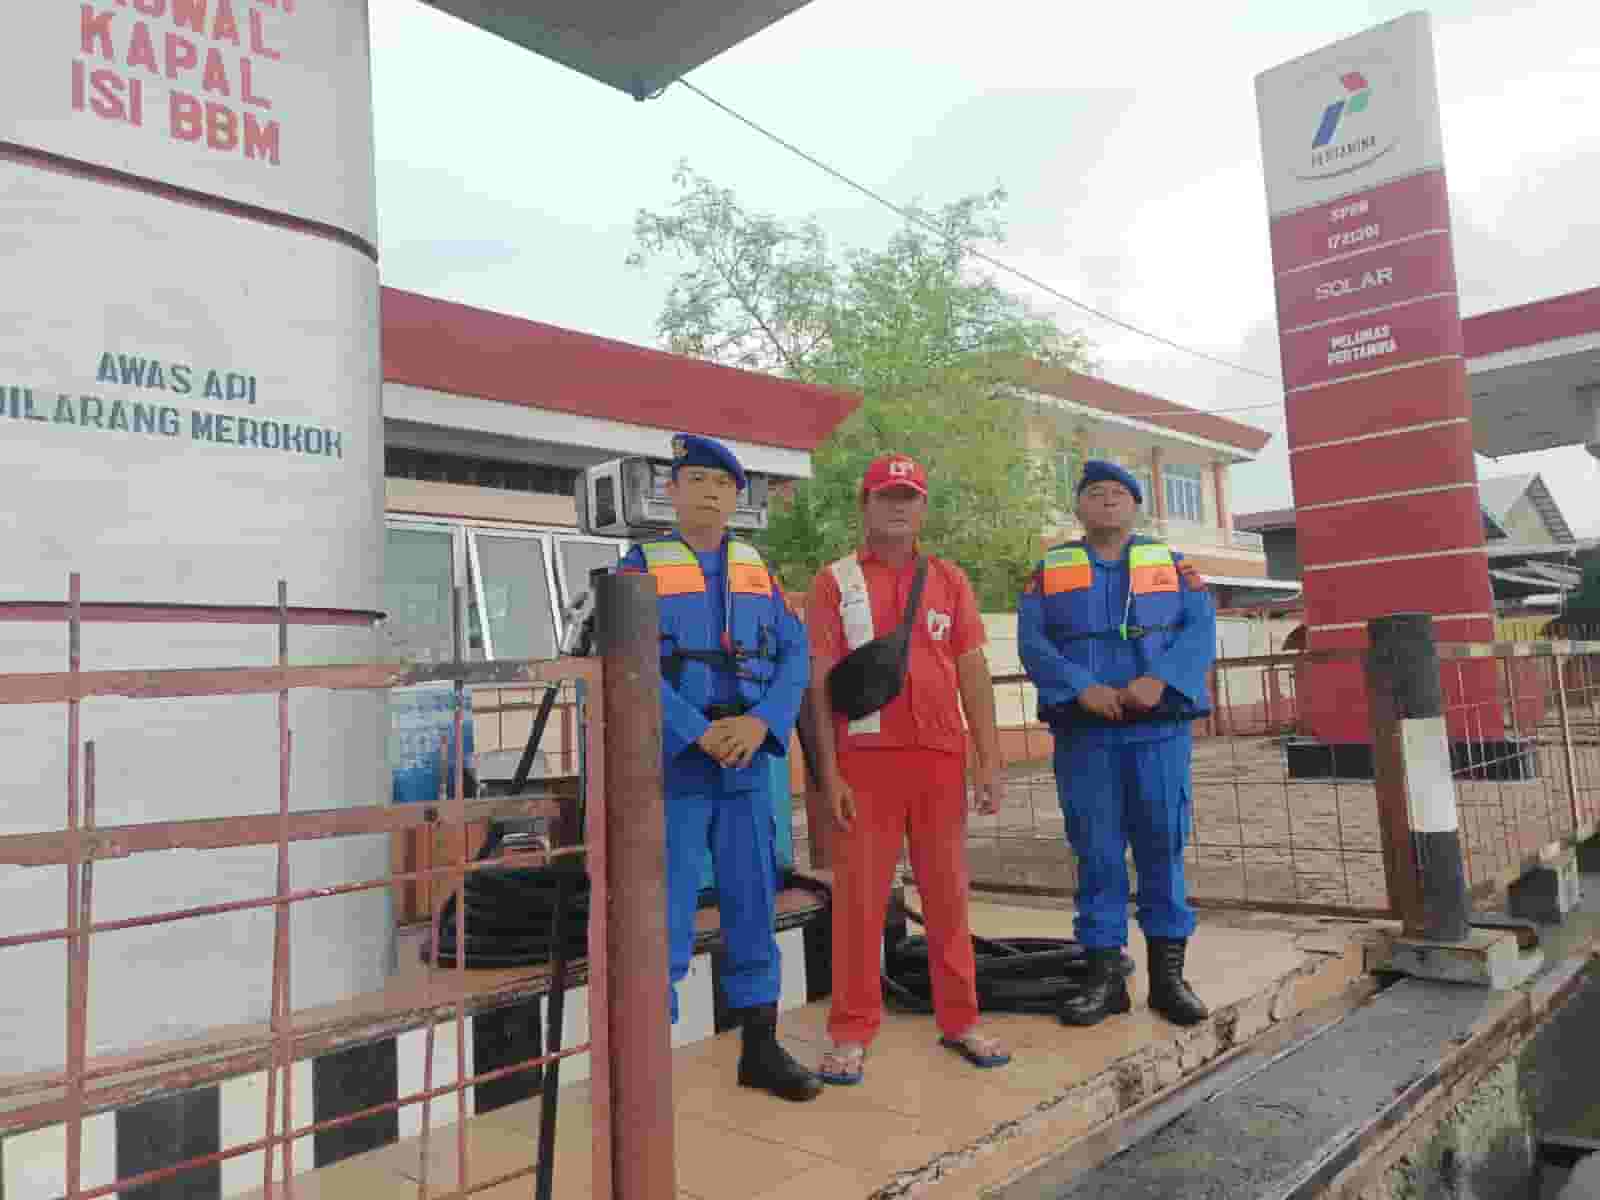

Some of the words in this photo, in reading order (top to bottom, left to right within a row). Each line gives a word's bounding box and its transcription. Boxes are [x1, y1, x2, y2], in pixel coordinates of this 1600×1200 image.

[80, 3, 273, 110] KAPAL
[71, 59, 143, 127] ISI
[169, 90, 280, 165] BBM
[1314, 266, 1393, 302] SOLAR
[96, 351, 193, 395] AWAS
[202, 368, 256, 404] API
[191, 409, 343, 459] MEROKOK
